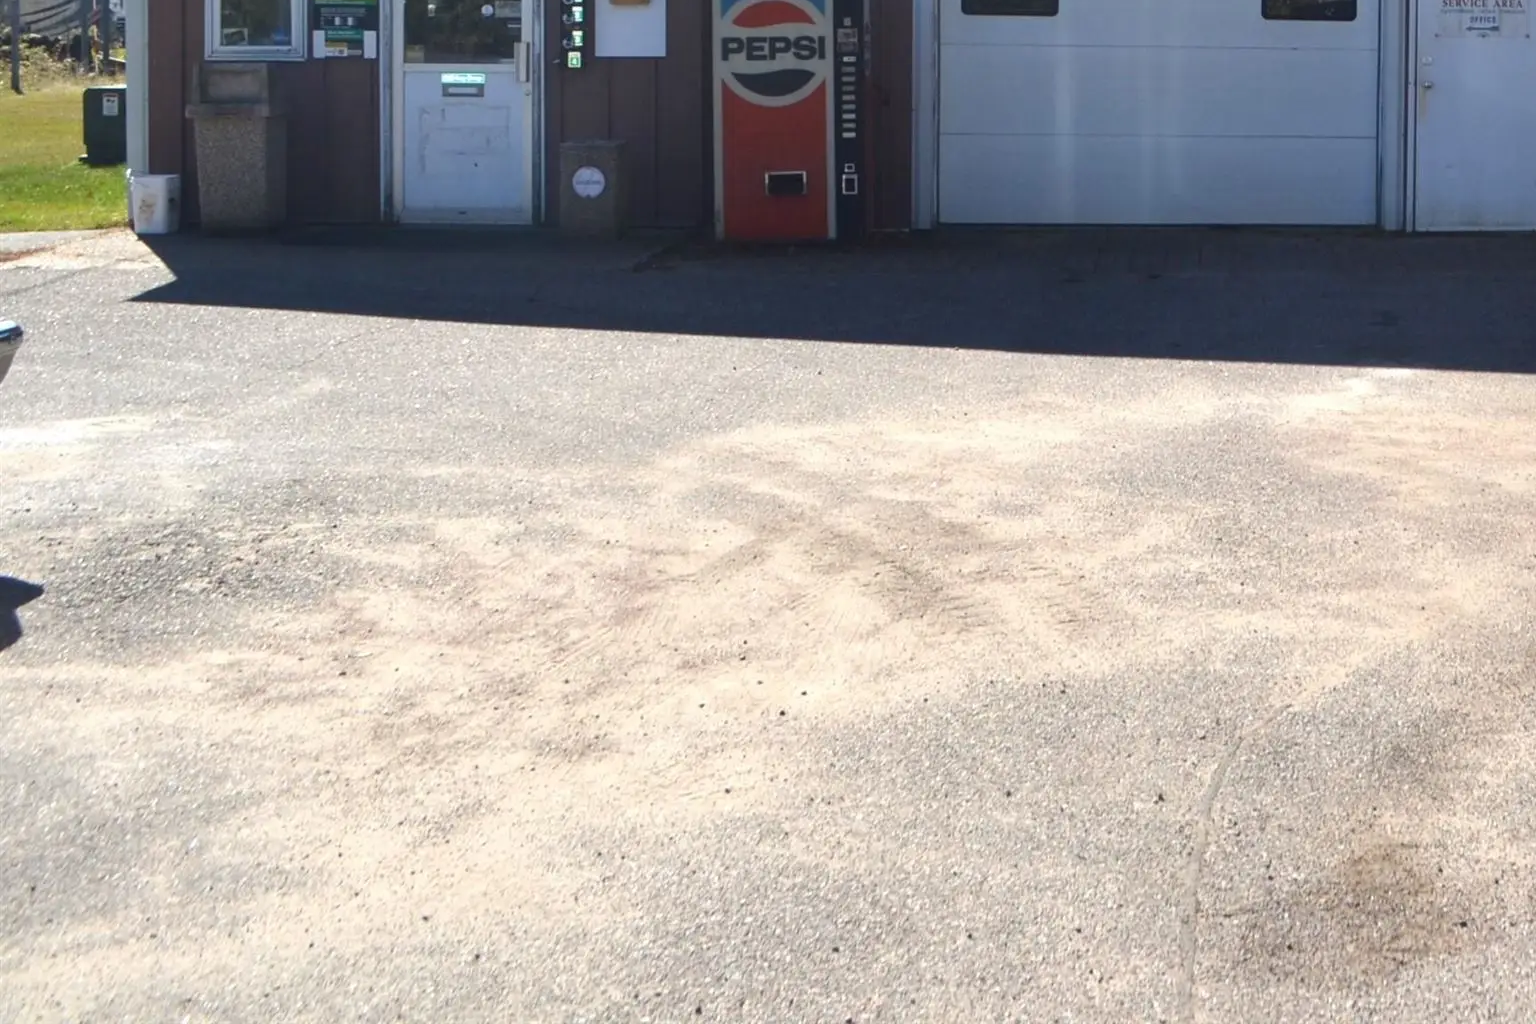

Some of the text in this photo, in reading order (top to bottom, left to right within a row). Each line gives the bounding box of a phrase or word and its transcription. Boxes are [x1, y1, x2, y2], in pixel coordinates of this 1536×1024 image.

[1442, 0, 1523, 8] SERVICE AREA
[1470, 16, 1497, 24] OFFICE
[720, 35, 827, 62] PEPSI
